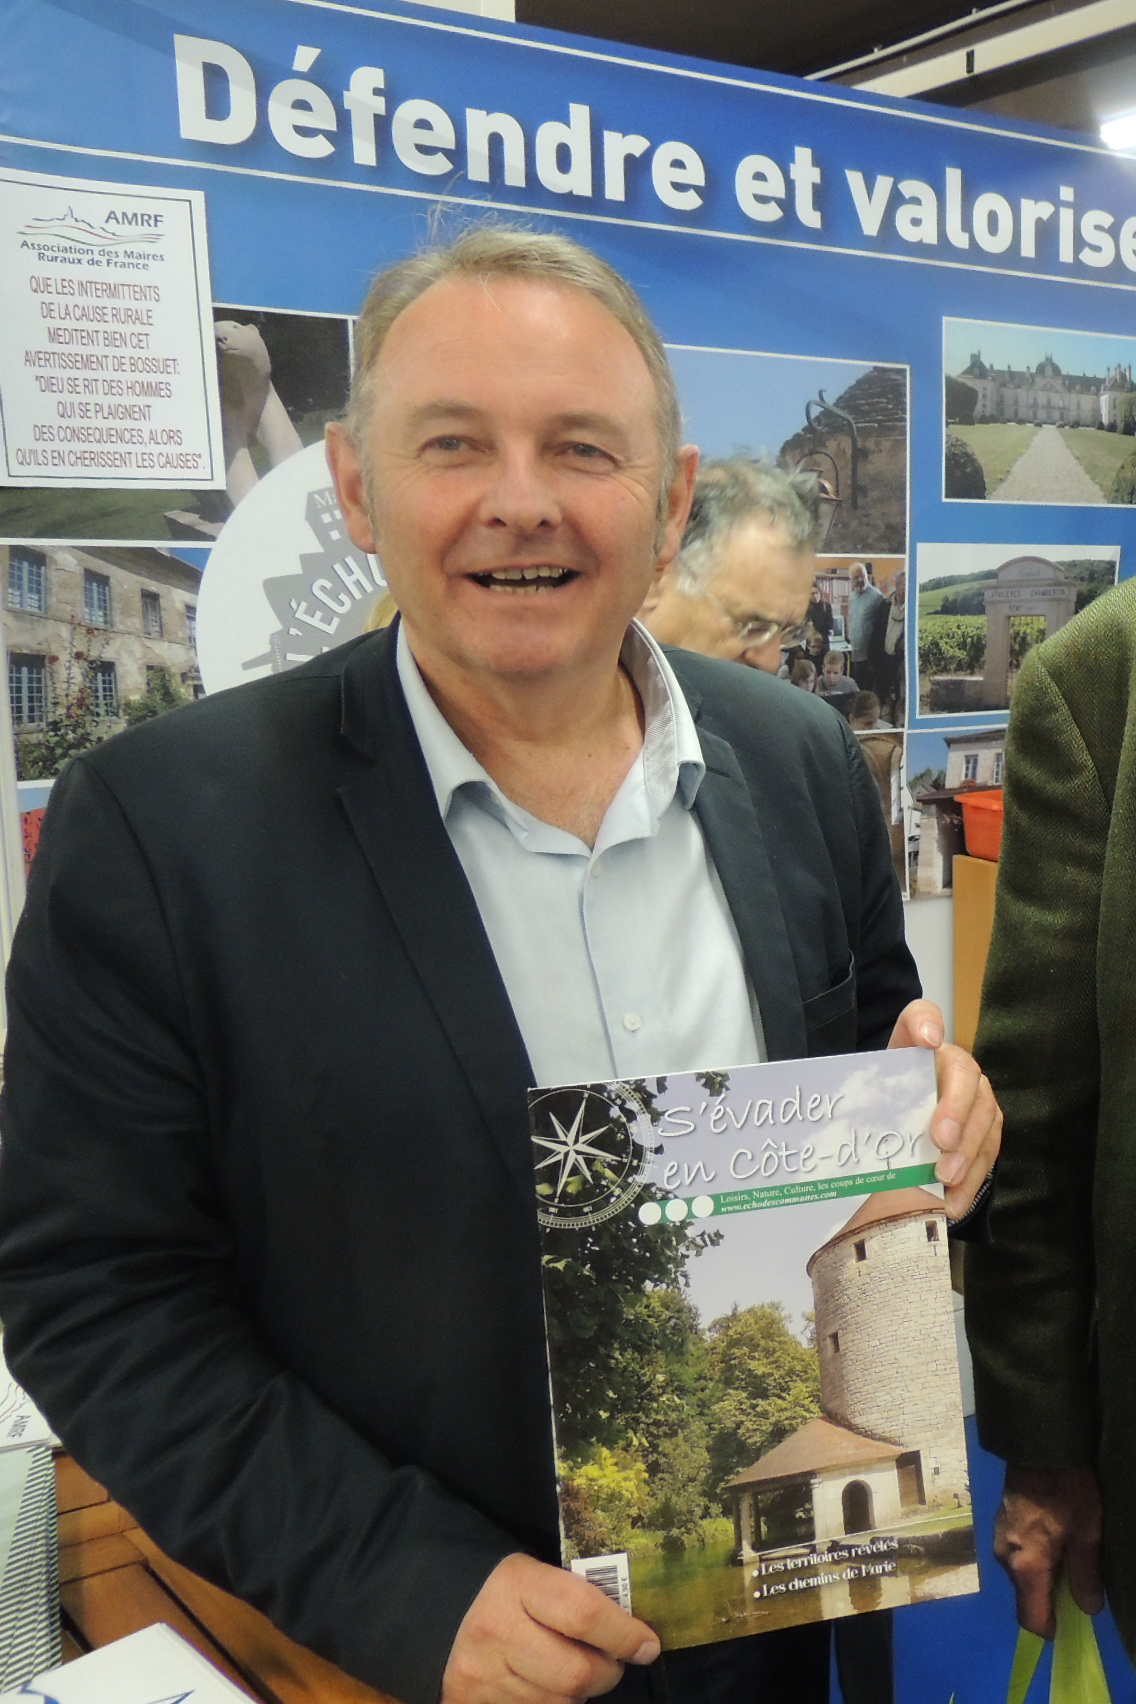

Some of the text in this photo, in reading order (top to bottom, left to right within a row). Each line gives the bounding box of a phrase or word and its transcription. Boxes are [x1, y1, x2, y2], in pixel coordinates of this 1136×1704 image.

[173, 34, 706, 211] Défendre
[735, 146, 821, 228] et
[104, 210, 164, 228] AMRF
[20, 240, 165, 262] Association des Maires
[37, 252, 149, 271] Ruraux de France
[30, 275, 160, 302] QUE LES INTERMITTENTS
[41, 301, 154, 326] DE LA CAUSE RURALE
[47, 327, 150, 350] MEDITENT BIEN CET
[24, 351, 180, 375] AVERTISSEMENT DE BOSSUET:
[35, 375, 172, 398] "DIEU SE RIT DES HOMMES
[57, 401, 152, 421] QUI SE PLAIGNENT
[33, 424, 183, 446] DES CONSEQUENCES, ALORS
[16, 448, 48, 466] QU'ILS
[51, 450, 66, 467] EN
[68, 450, 133, 468] CHERISSENT
[135, 452, 155, 468] LES
[658, 1085, 844, 1137] S'évader
[663, 1129, 925, 1190] en Côte-d'Or
[720, 1193, 750, 1205] Loisirs,
[753, 1189, 783, 1202] Nature,
[784, 1185, 815, 1197] Culture,
[818, 1181, 829, 1190] les
[831, 1179, 854, 1191] coups
[855, 1176, 865, 1184] de
[887, 1172, 896, 1181] de
[761, 1562, 784, 1576] Les
[762, 1560, 897, 1597] Les chemins de Marie
